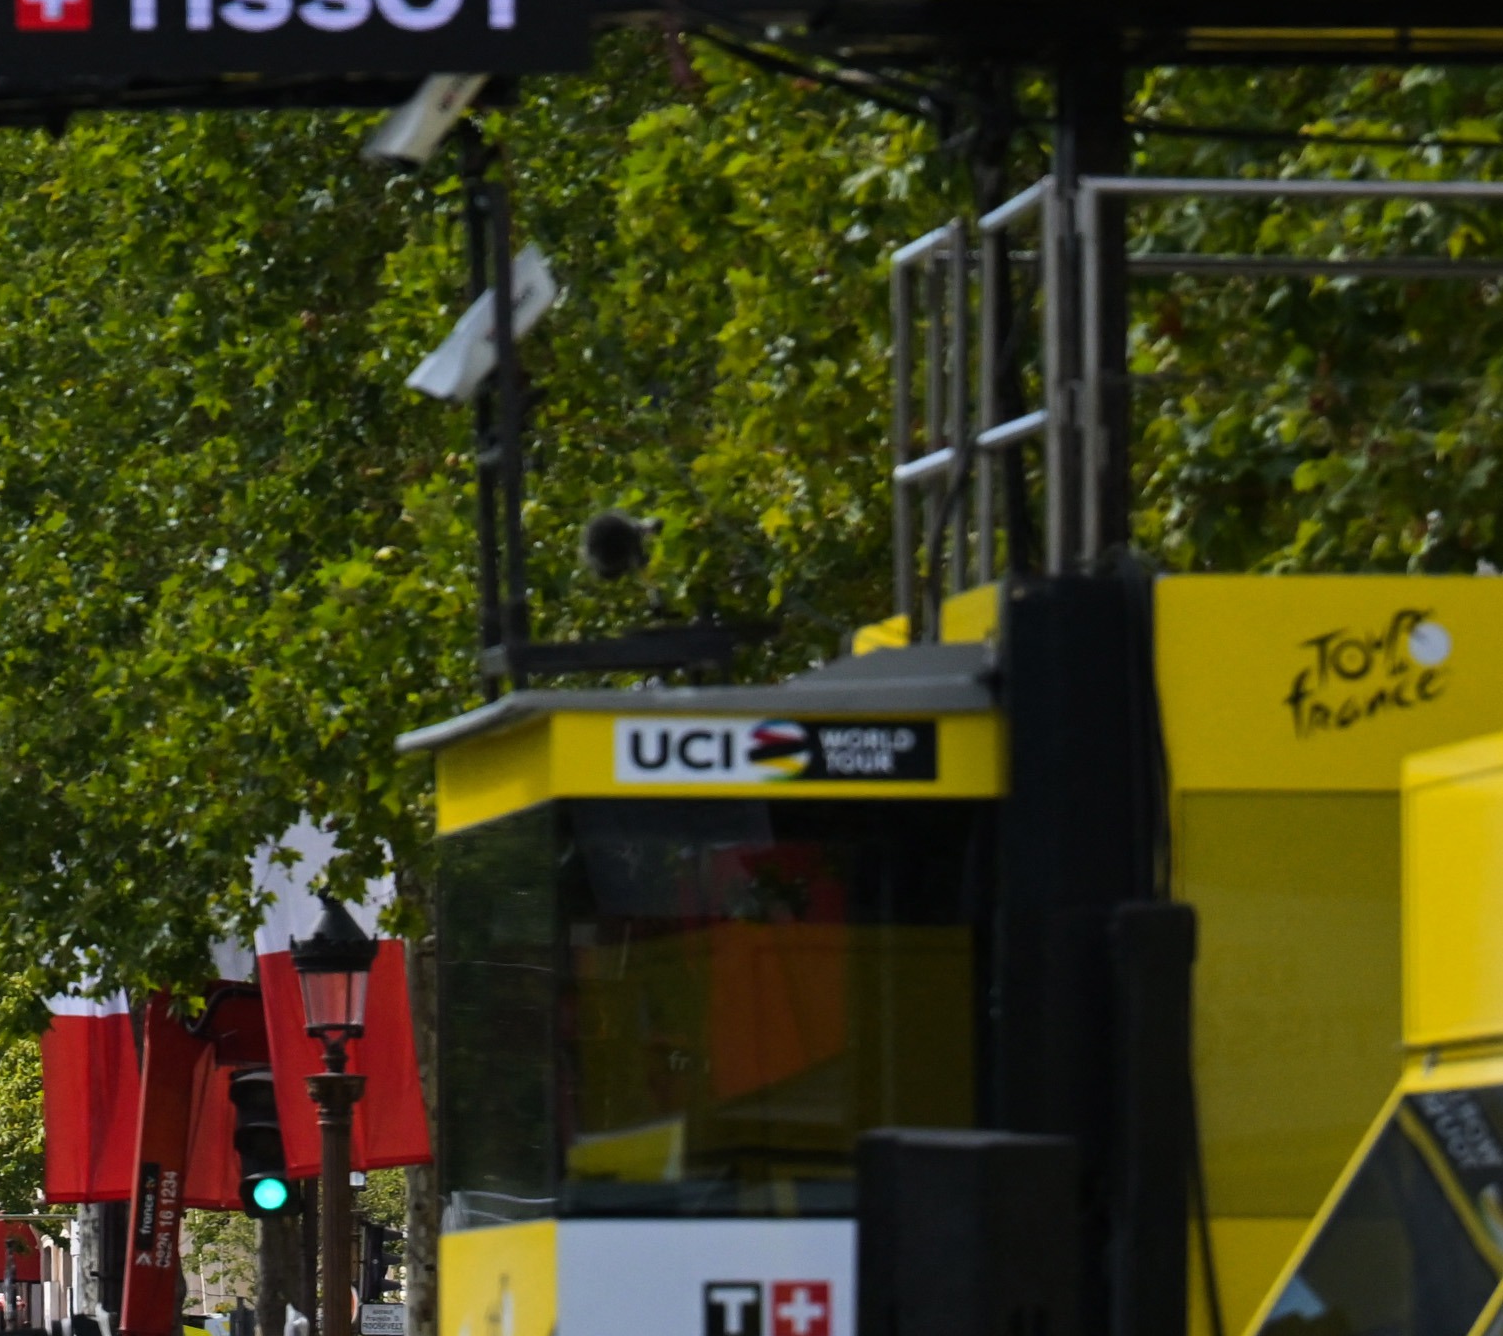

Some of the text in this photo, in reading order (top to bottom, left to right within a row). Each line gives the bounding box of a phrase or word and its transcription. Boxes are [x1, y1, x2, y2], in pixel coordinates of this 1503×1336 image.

[630, 730, 734, 770] UCI
[819, 727, 916, 752] WORLD
[826, 751, 894, 773] TOUR
[708, 1287, 757, 1336] T
